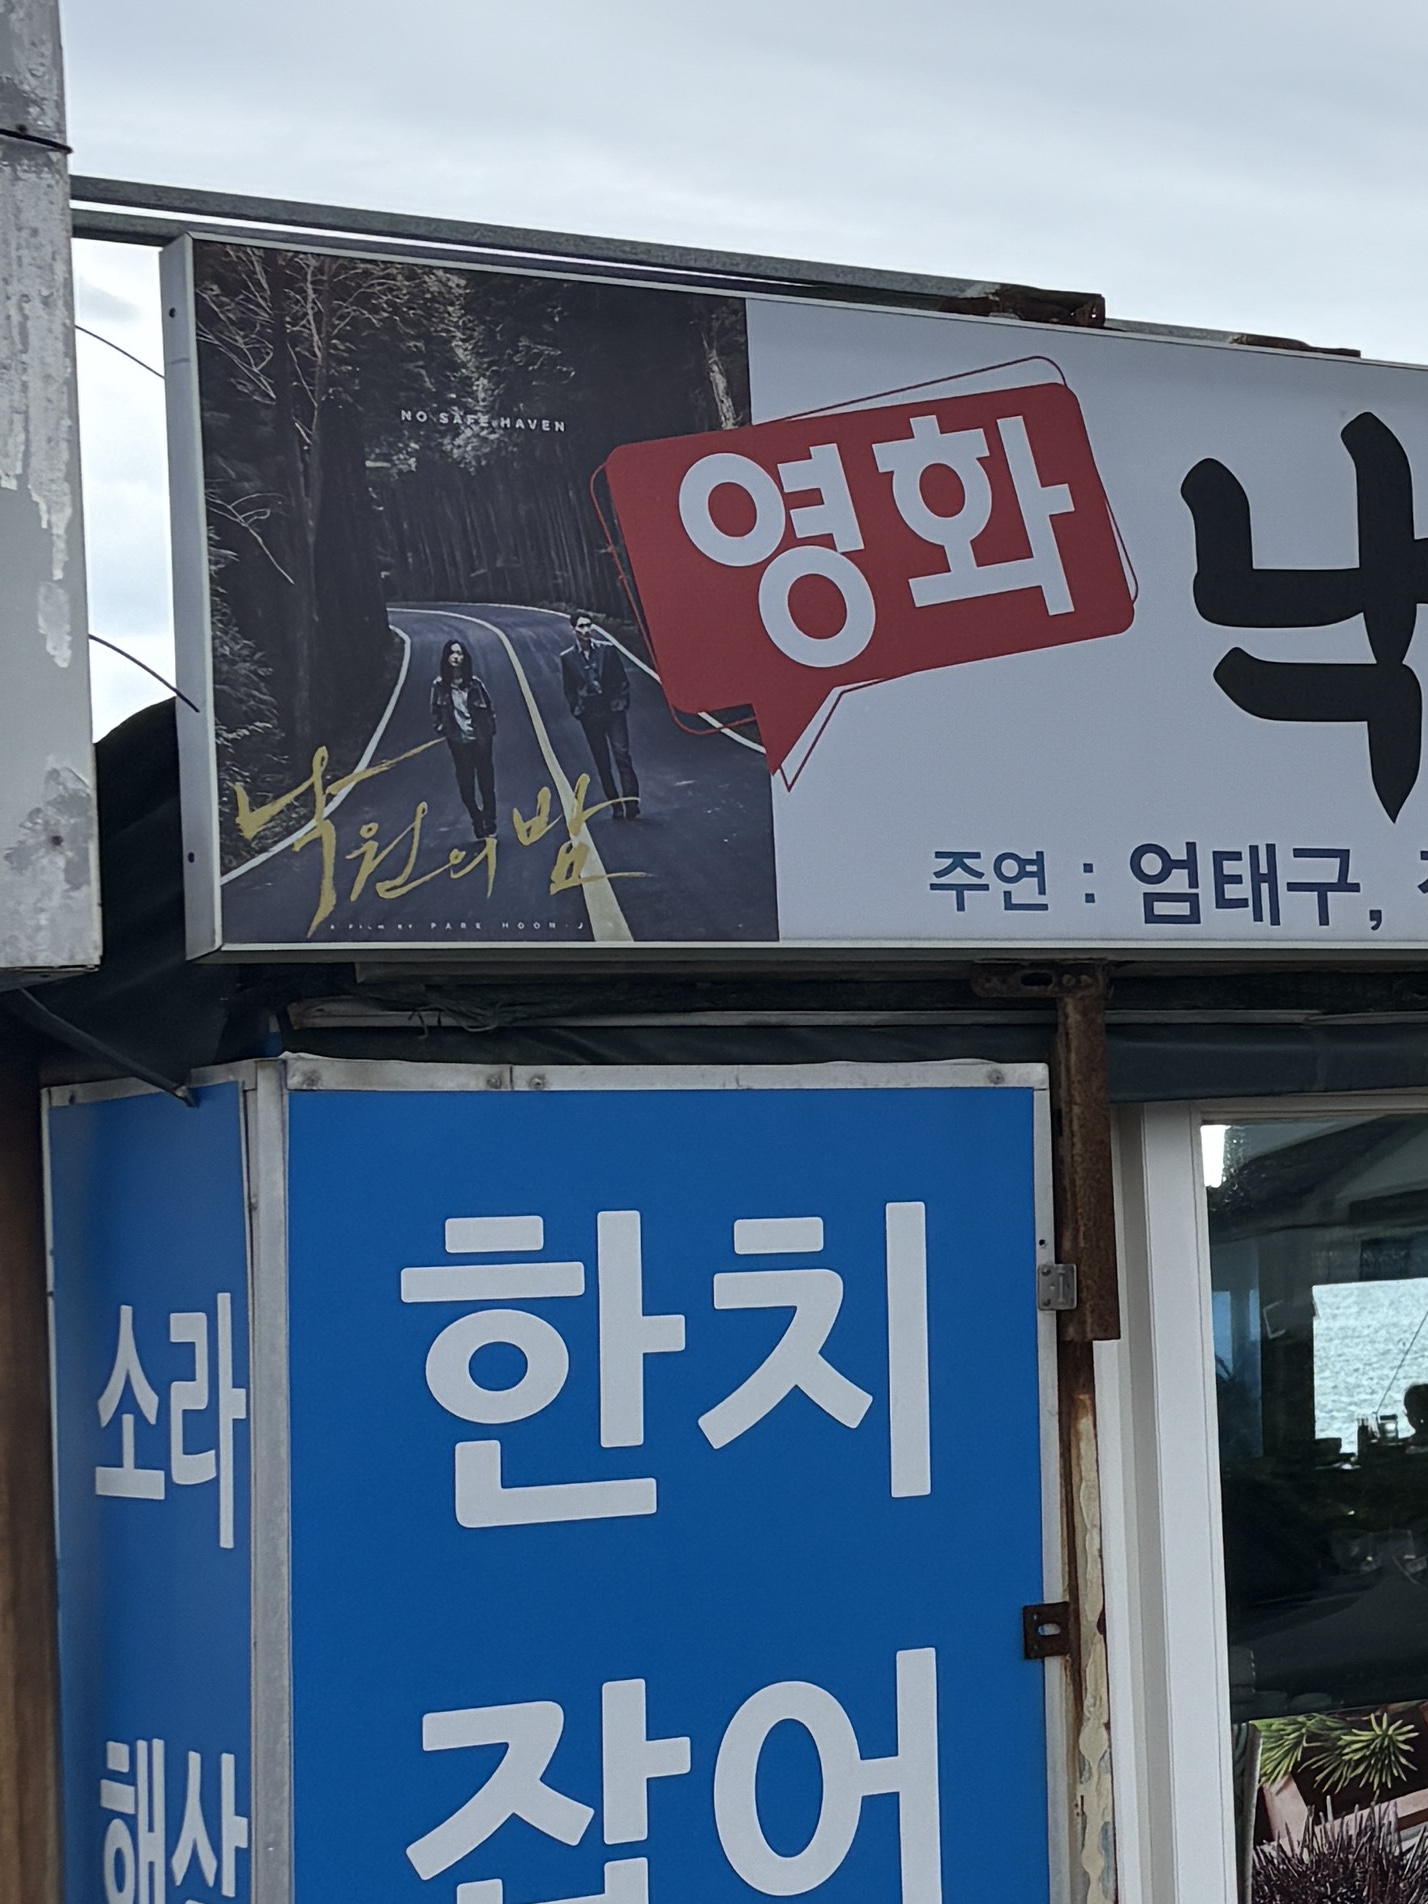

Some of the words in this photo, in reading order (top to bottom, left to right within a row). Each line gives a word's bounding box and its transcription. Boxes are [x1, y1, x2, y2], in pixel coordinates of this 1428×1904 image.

[400, 409, 428, 423] NO
[438, 411, 490, 428] SAFE
[500, 416, 566, 433] HAVEN
[679, 415, 1075, 668] 영화
[235, 745, 498, 938] 낙원의
[514, 773, 653, 896] 밤
[929, 850, 1049, 912] 주연
[1129, 840, 1383, 931] 엄태구,
[95, 1291, 247, 1549] 소라
[400, 1200, 931, 1529] 한치
